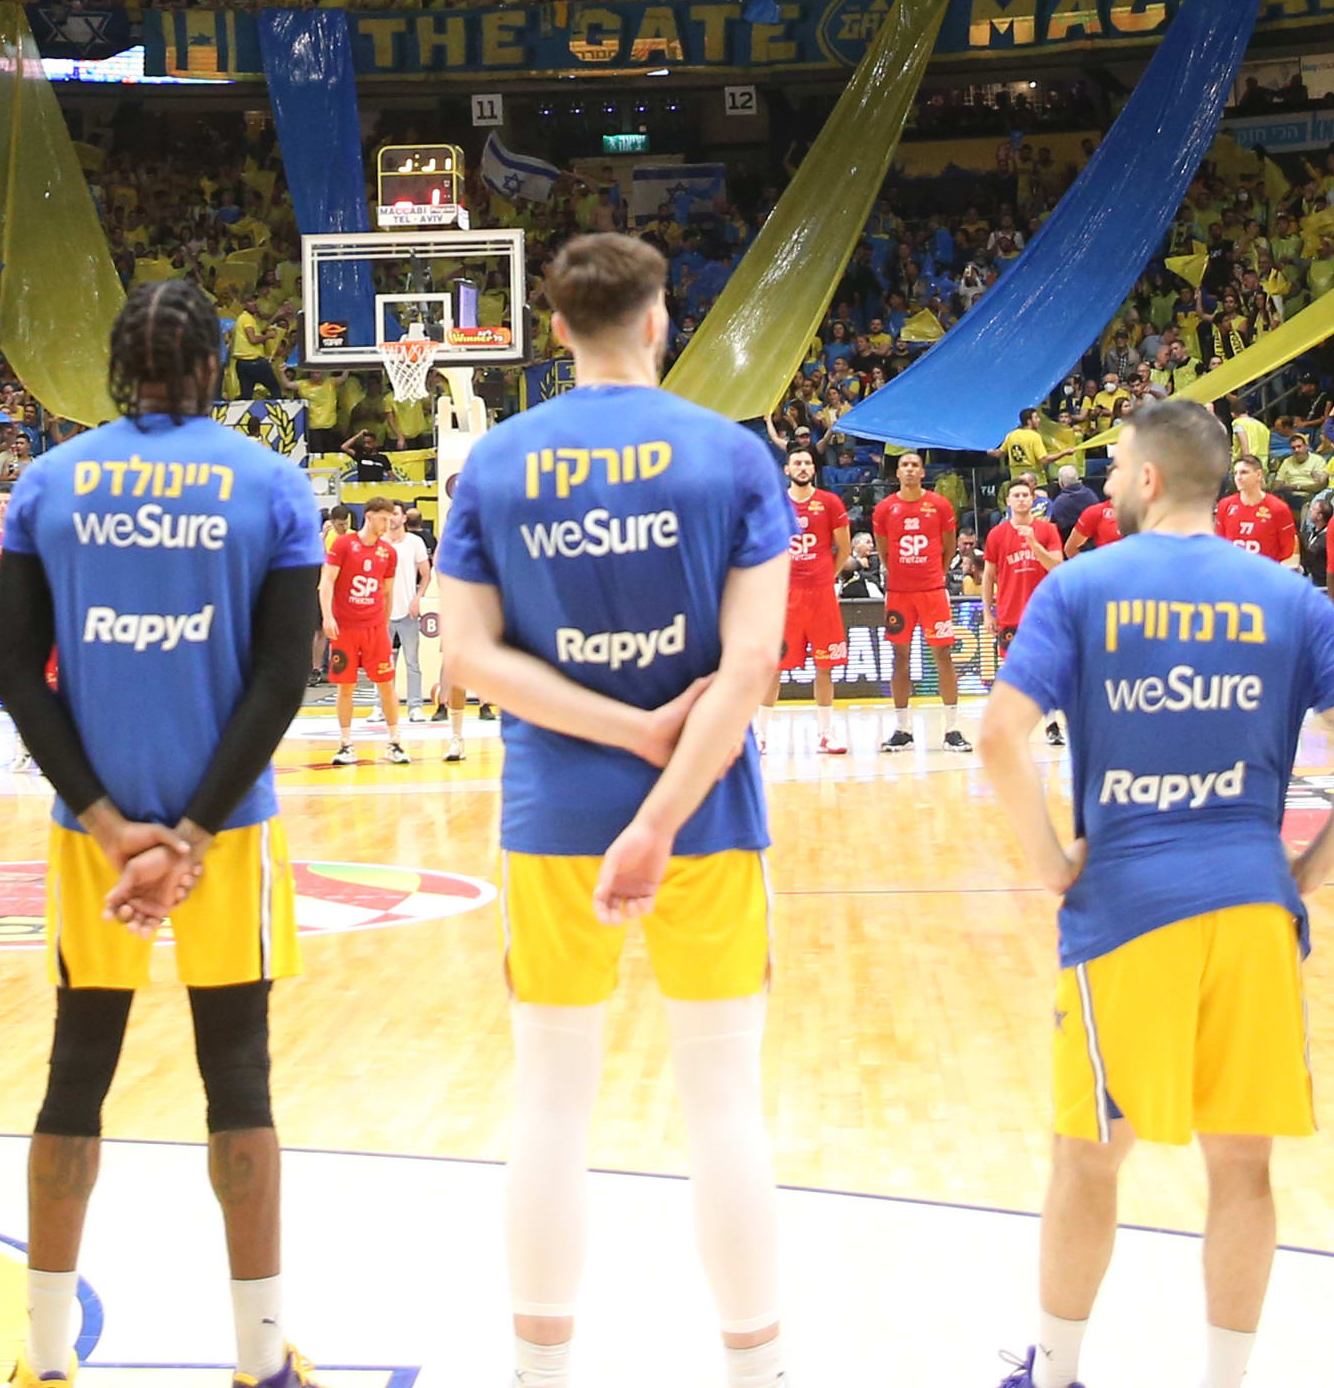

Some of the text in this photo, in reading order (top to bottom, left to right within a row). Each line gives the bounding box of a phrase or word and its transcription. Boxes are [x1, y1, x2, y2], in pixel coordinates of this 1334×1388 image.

[367, 4, 801, 68] THE GATE
[475, 100, 499, 123] 11
[727, 88, 753, 110] 12
[419, 214, 444, 223] AVIV
[73, 454, 235, 503] ריינולדס
[525, 440, 673, 499] סורקין
[73, 504, 229, 550] weSure
[520, 508, 679, 560] weSure
[904, 518, 921, 531] 22
[1239, 521, 1255, 535] 77
[788, 534, 818, 554] SP
[899, 535, 928, 556] SP
[899, 555, 928, 564] metzer
[350, 575, 379, 597] SP
[84, 605, 215, 653] Rapyd
[427, 617, 437, 632] B
[1105, 599, 1267, 653] ברנדוויין
[557, 614, 687, 671] Rapyd
[1105, 665, 1263, 713] weSure
[1100, 760, 1246, 810] Rapyd
